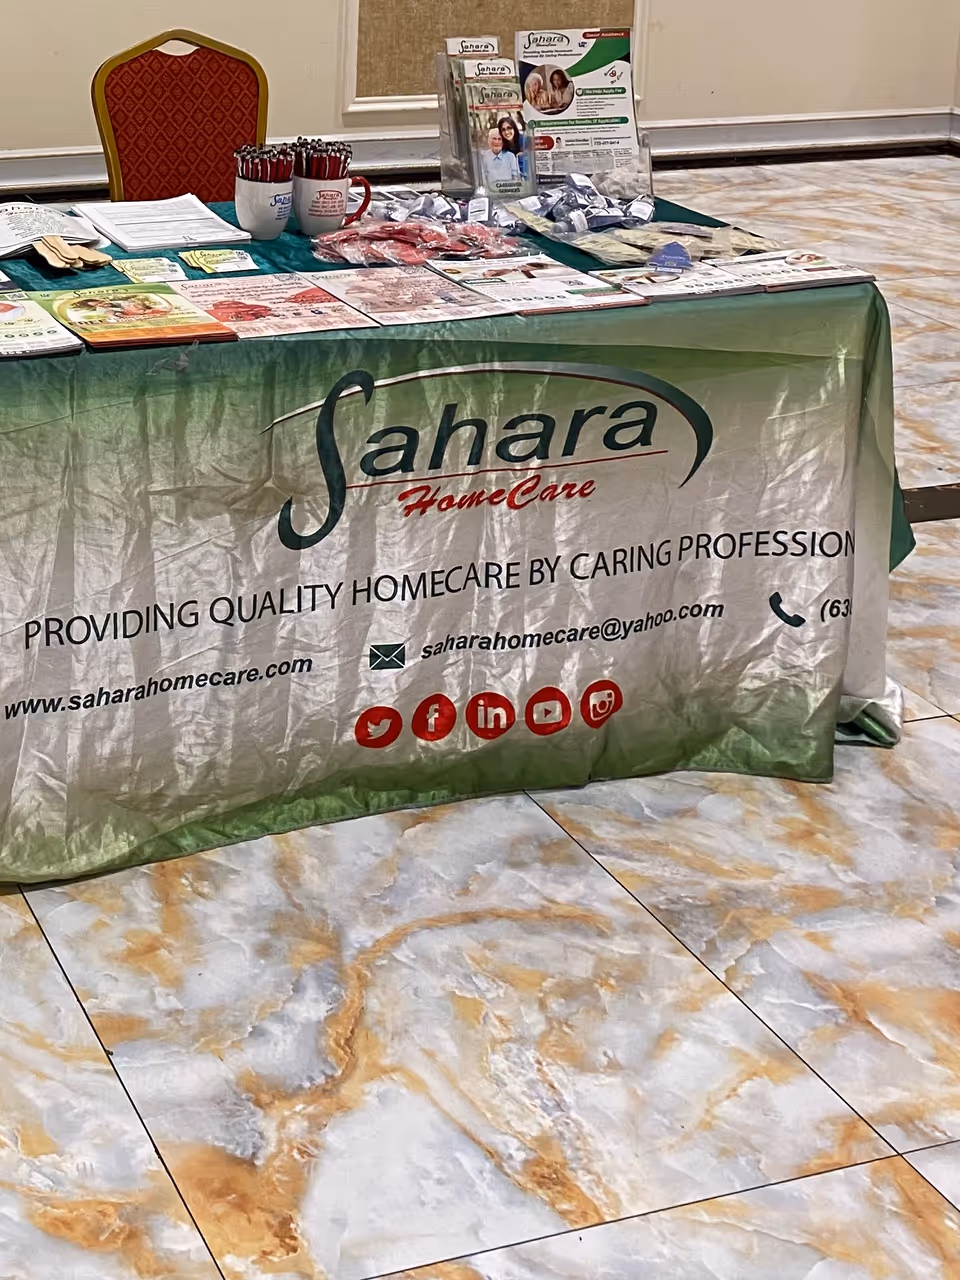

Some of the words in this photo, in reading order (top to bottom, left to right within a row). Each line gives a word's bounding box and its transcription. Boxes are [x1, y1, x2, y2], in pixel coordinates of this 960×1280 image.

[277, 370, 656, 551] Sahara
[398, 476, 595, 520] HomeCare
[25, 600, 198, 650] PROVIDING
[210, 582, 343, 627] QUALITY
[352, 562, 520, 605] HOMECARE
[530, 556, 561, 585] BY
[570, 540, 671, 580] CARING
[820, 598, 852, 622] (63
[421, 604, 724, 659] saharahomecare@yahoo.com
[5, 659, 312, 720] www.saharahomecare.com
